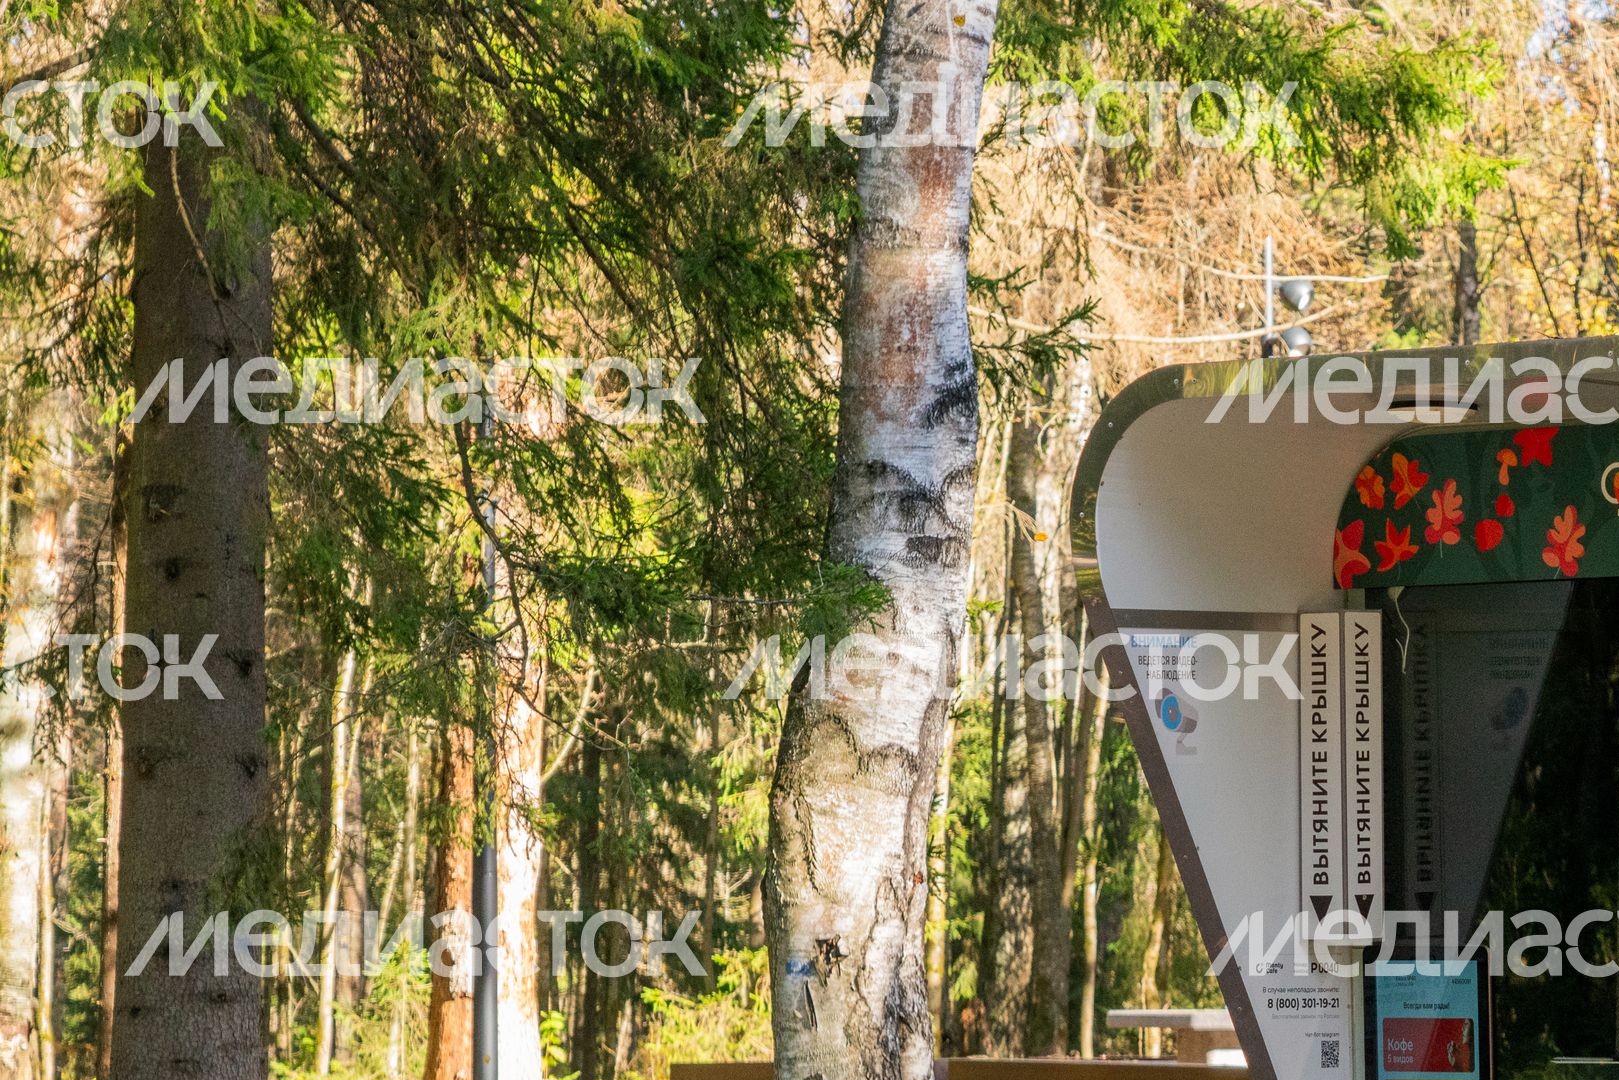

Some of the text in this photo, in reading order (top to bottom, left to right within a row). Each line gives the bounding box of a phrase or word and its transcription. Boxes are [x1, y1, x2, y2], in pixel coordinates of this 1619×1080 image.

[1130, 634, 1199, 648] ВНИМАНИЕ
[1146, 669, 1197, 682] НАБЛЮДЕНИЕ
[1310, 623, 1329, 886] ВЫТЯНИТЕ КРЫШКУ
[1354, 622, 1371, 884] ВЫТЯНИТЕ КРЫШКУ
[1267, 997, 1340, 1011] 8 (800) 301-19-21
[1387, 1038, 1414, 1054] Кофе
[1387, 1055, 1414, 1064] 5 видов
